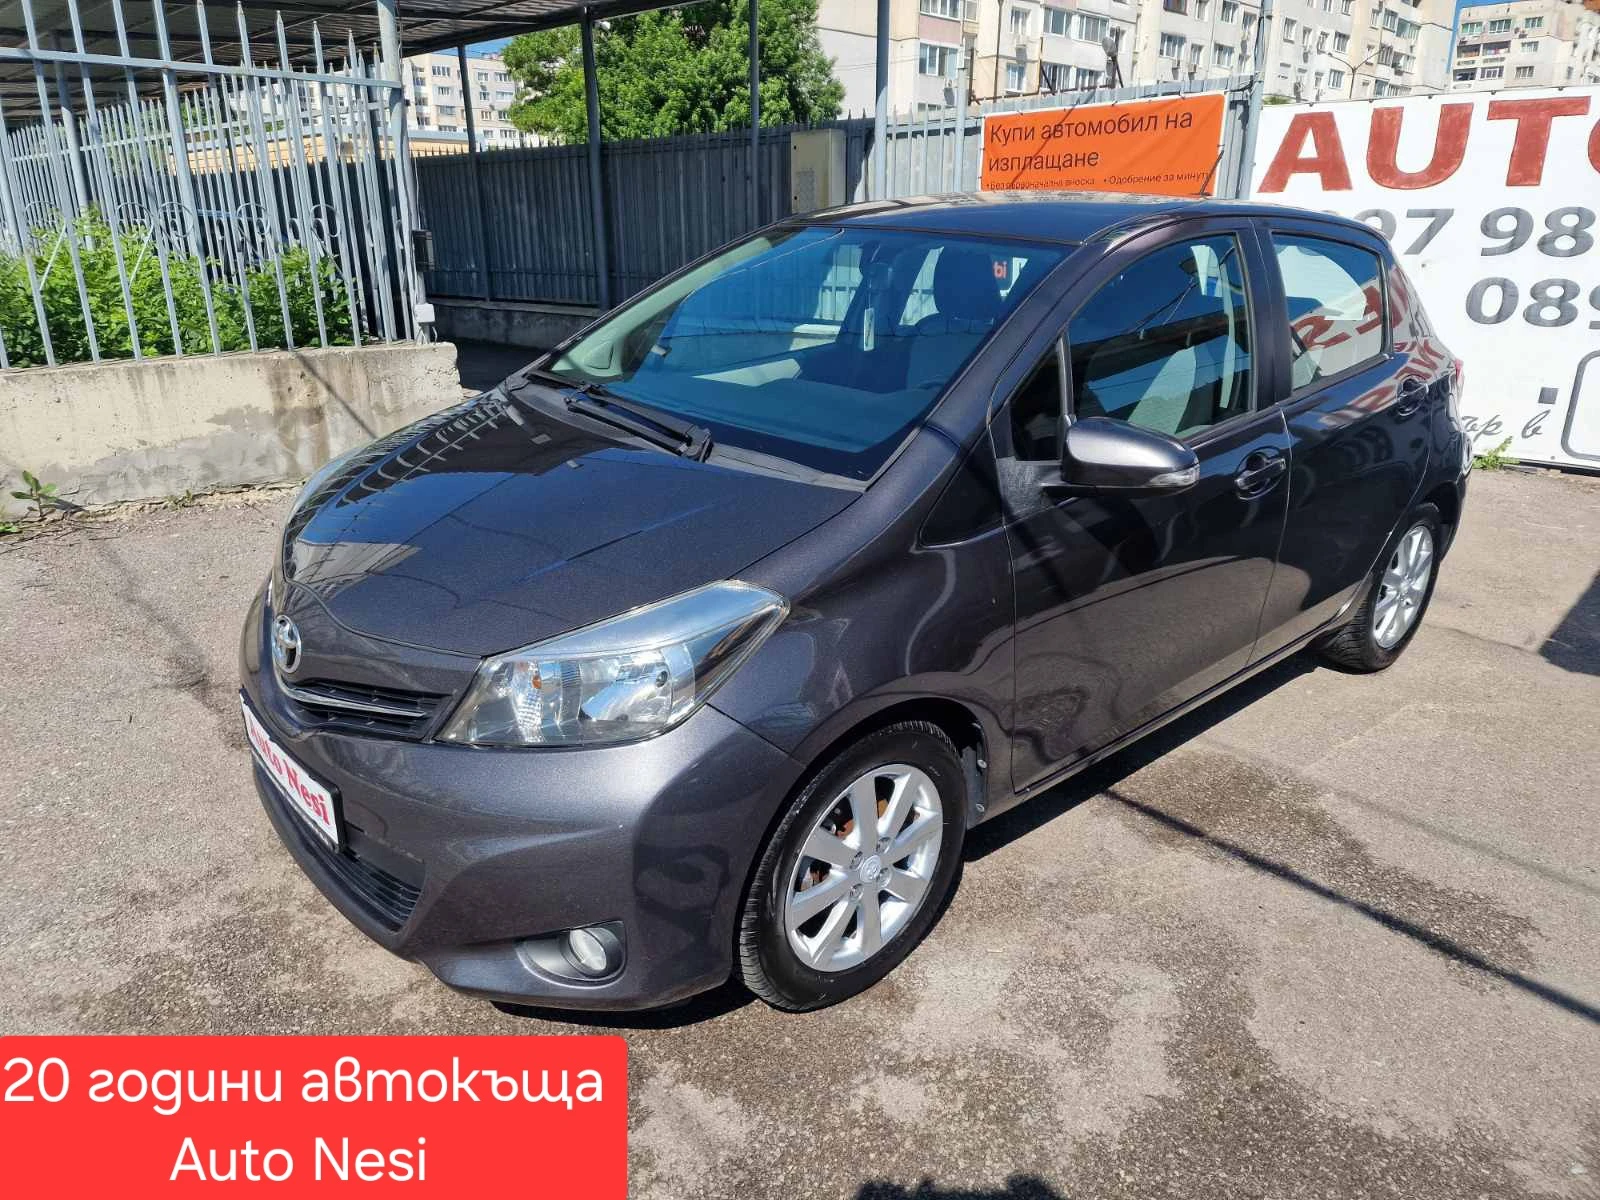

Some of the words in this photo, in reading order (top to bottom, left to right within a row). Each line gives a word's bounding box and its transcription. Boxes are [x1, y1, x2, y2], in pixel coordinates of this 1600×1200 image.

[990, 122, 1035, 147] Купи
[1041, 113, 1158, 140] автомобил
[1165, 111, 1193, 129] на
[1257, 95, 1600, 193] AUT
[988, 150, 1100, 173] изплащане
[1163, 173, 1175, 181] за
[1465, 276, 1600, 330] 08
[250, 722, 284, 776] Auto
[283, 758, 330, 826] Nesi
